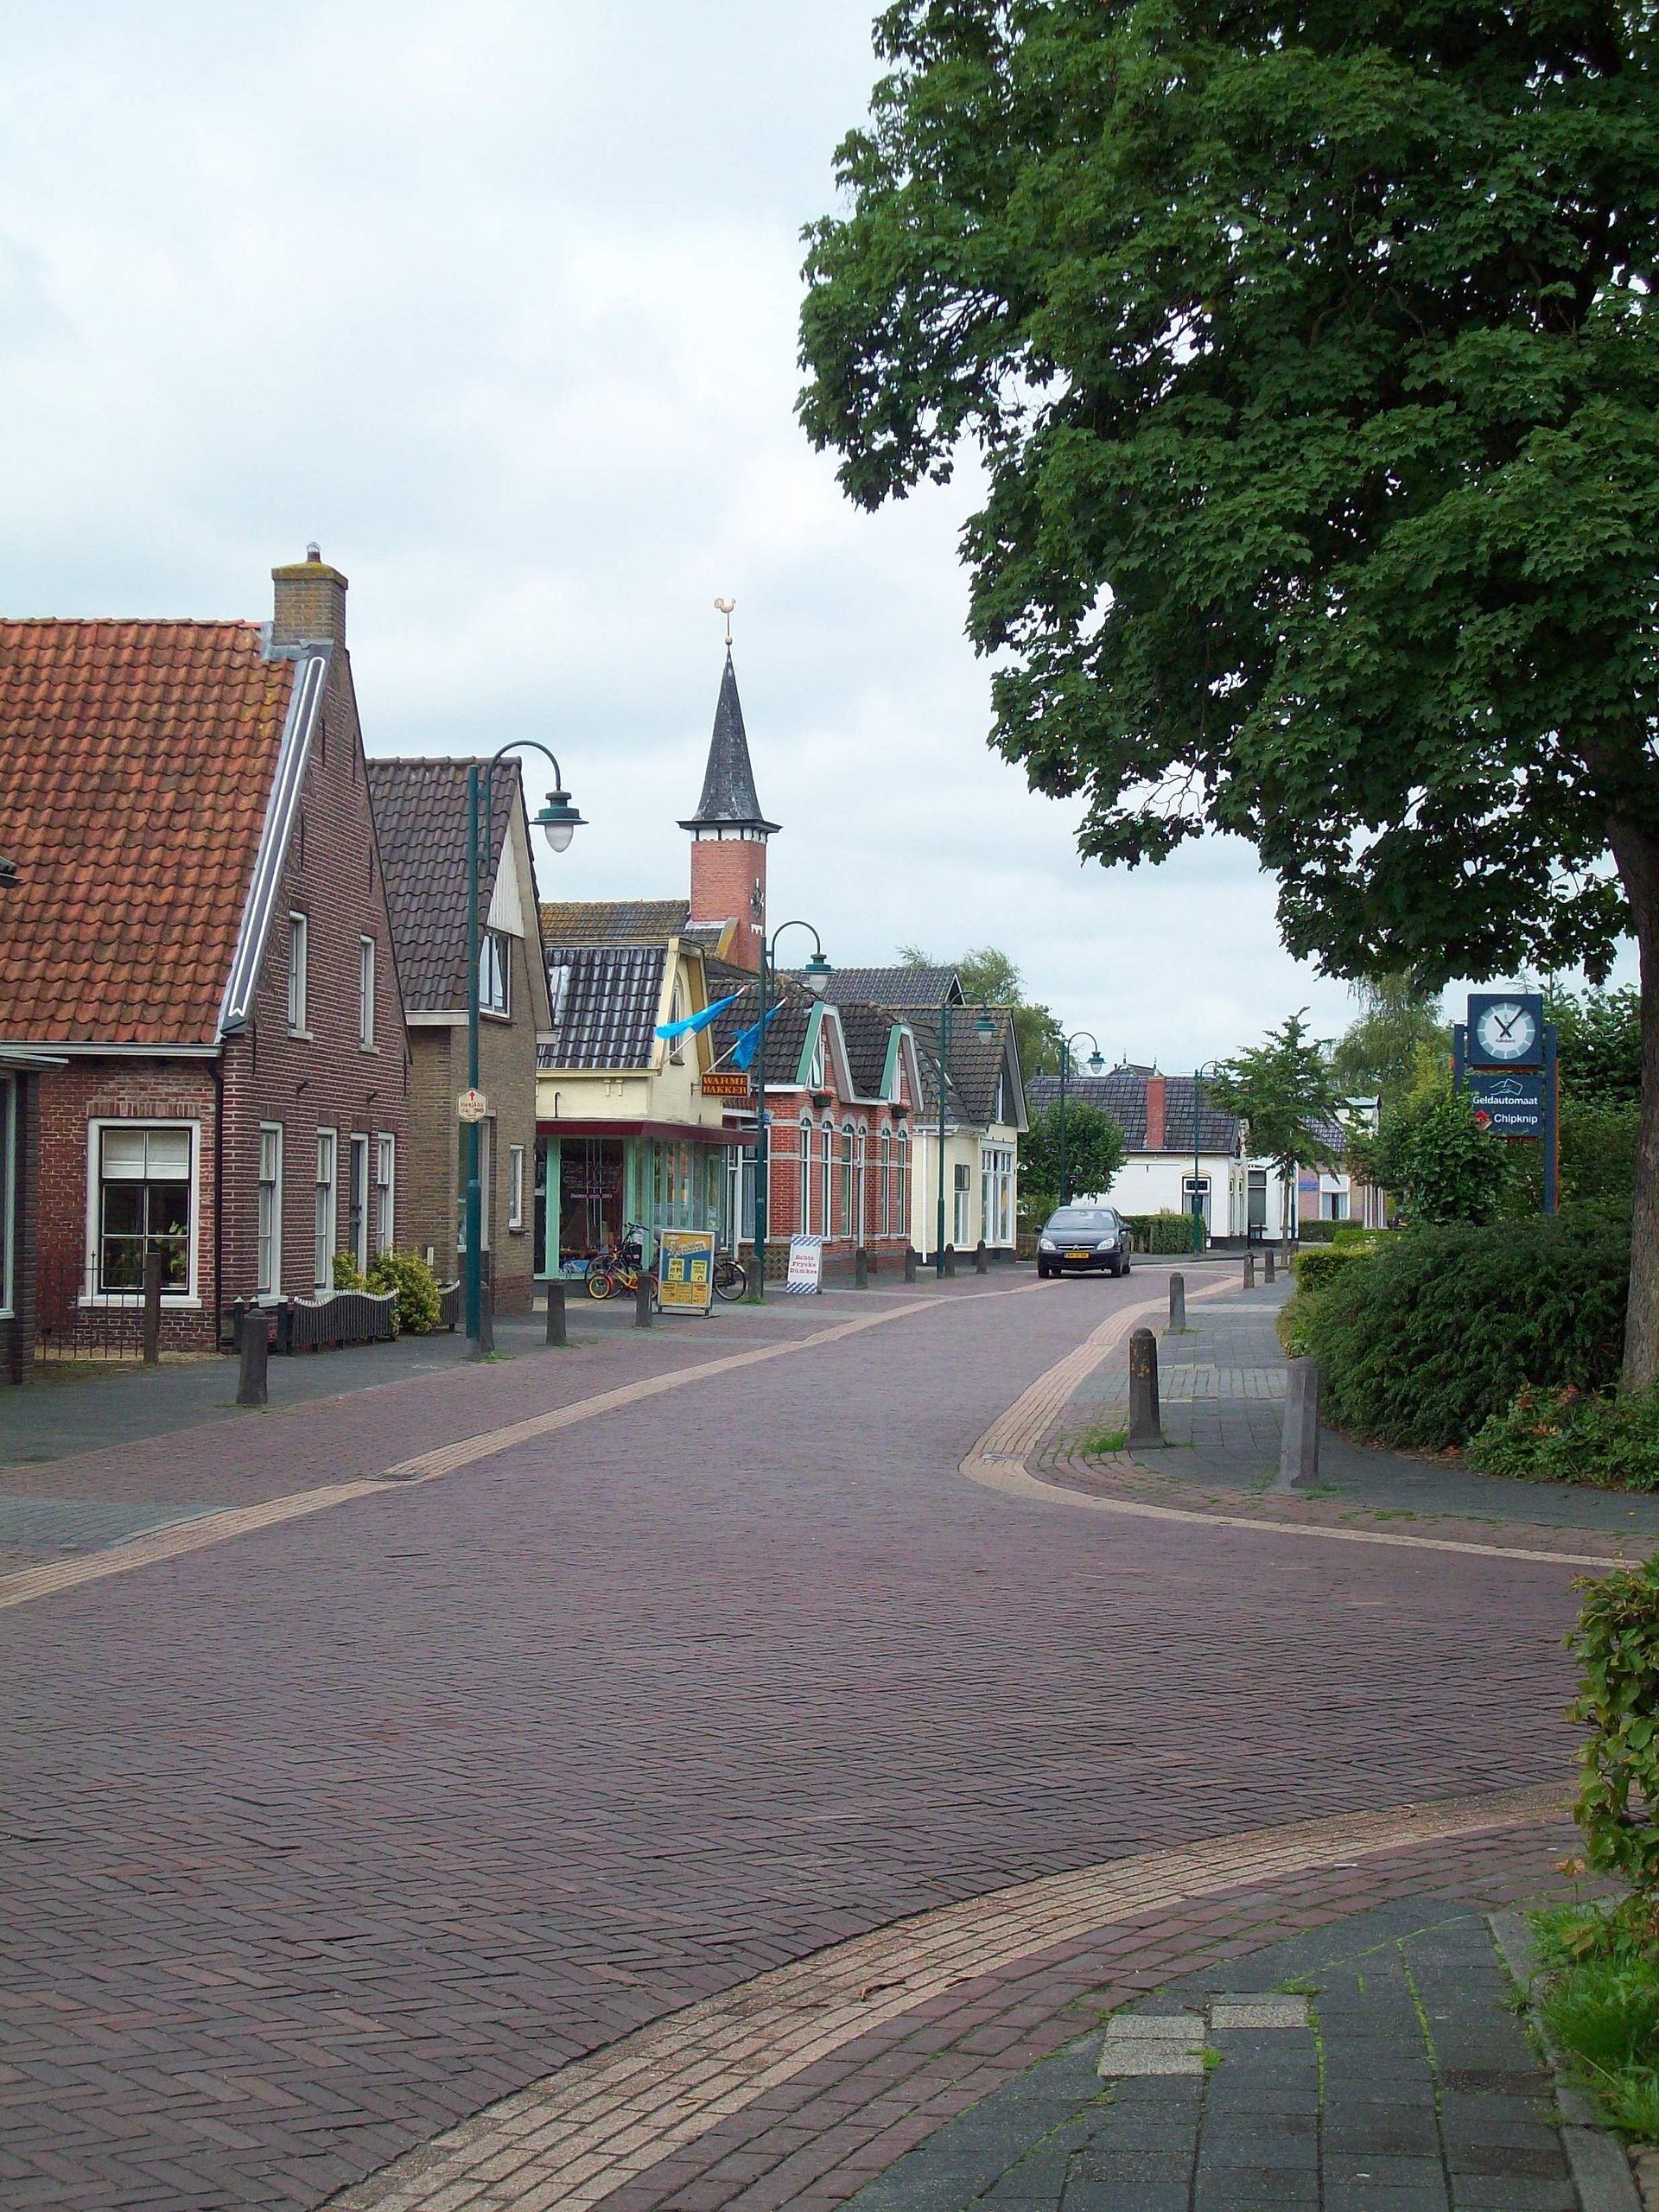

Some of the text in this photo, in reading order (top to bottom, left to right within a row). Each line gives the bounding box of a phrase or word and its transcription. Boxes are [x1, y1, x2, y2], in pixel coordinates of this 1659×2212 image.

[703, 1077, 747, 1085] WARME
[703, 1085, 747, 1094] BAKKER
[1472, 1096, 1538, 1105] Geldautomaat
[1494, 1114, 1538, 1125] Chipknip
